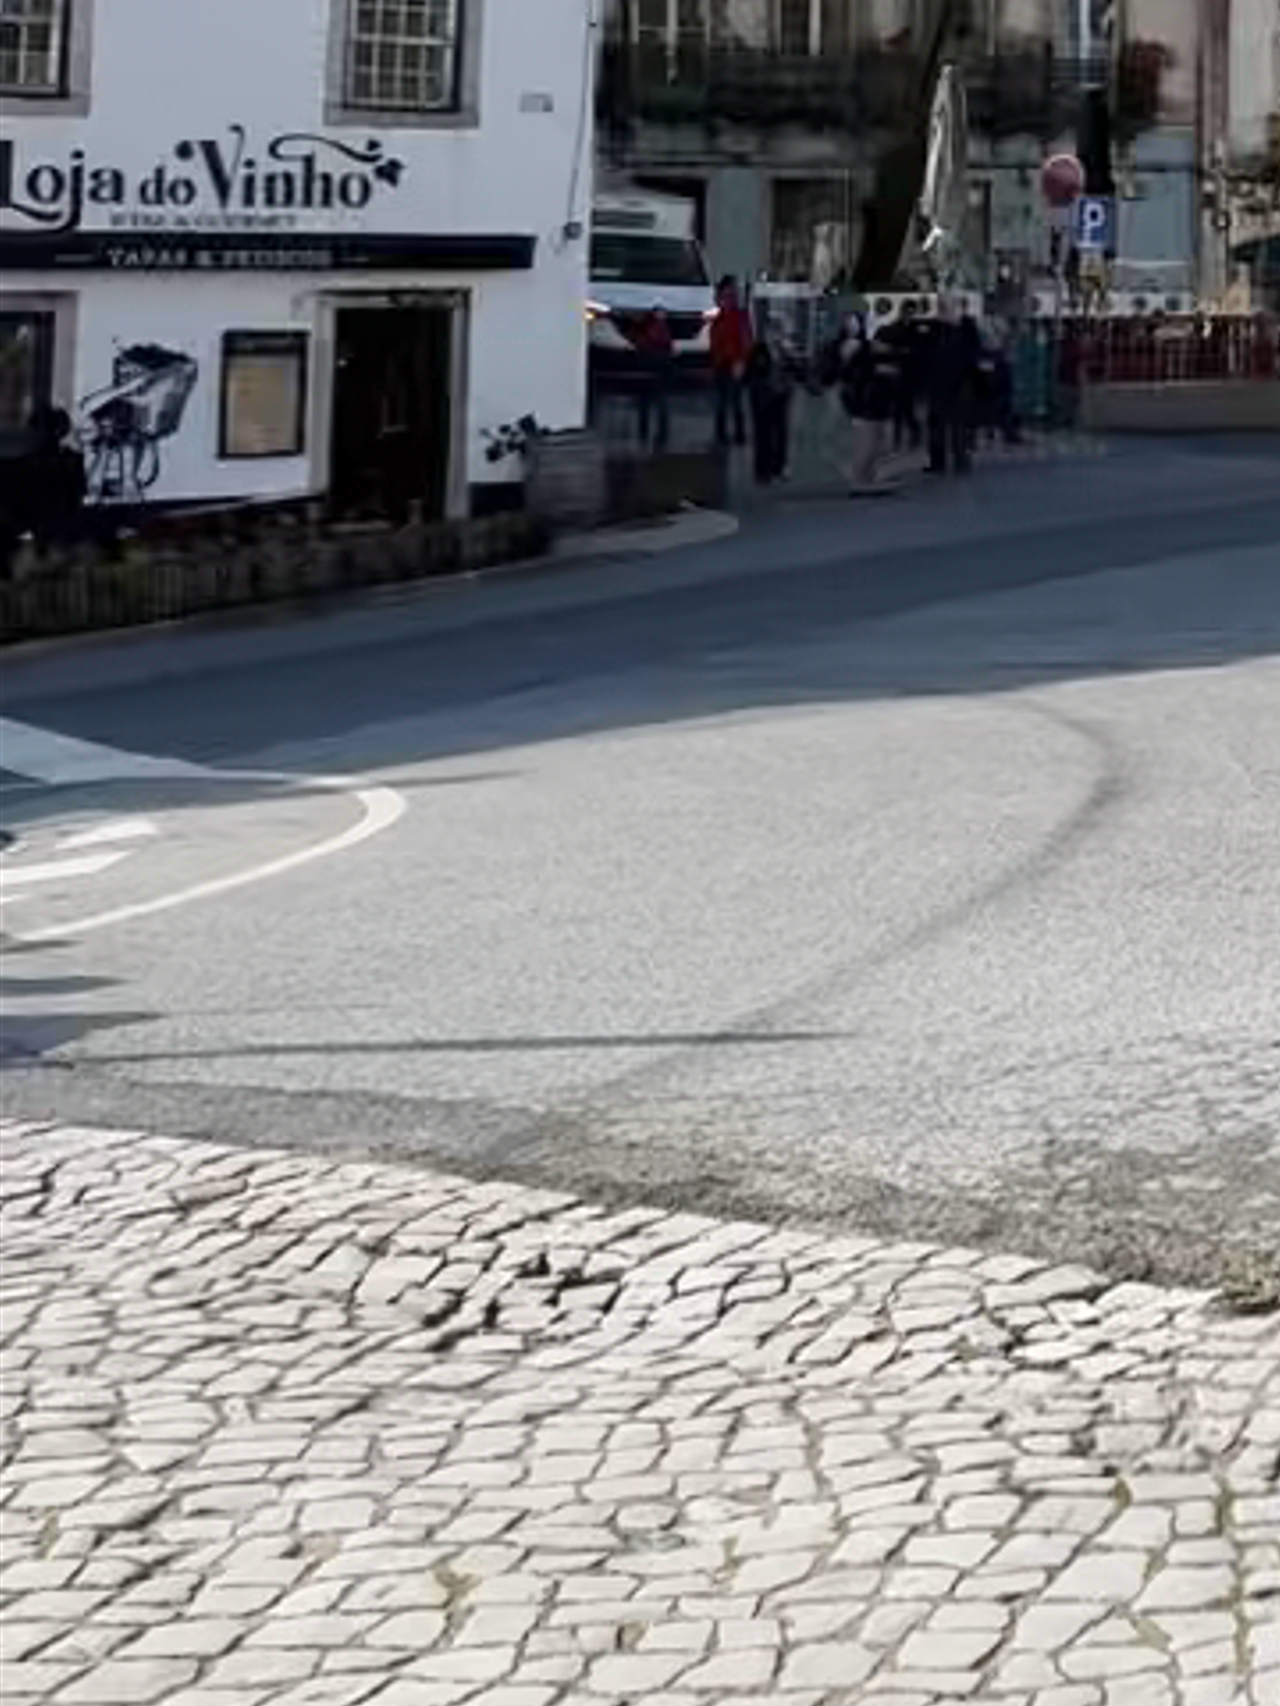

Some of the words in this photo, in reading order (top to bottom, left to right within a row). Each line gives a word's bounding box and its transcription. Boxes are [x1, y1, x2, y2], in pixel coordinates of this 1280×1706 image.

[139, 166, 198, 206] do
[174, 125, 384, 209] Vinho
[1083, 203, 1104, 246] P
